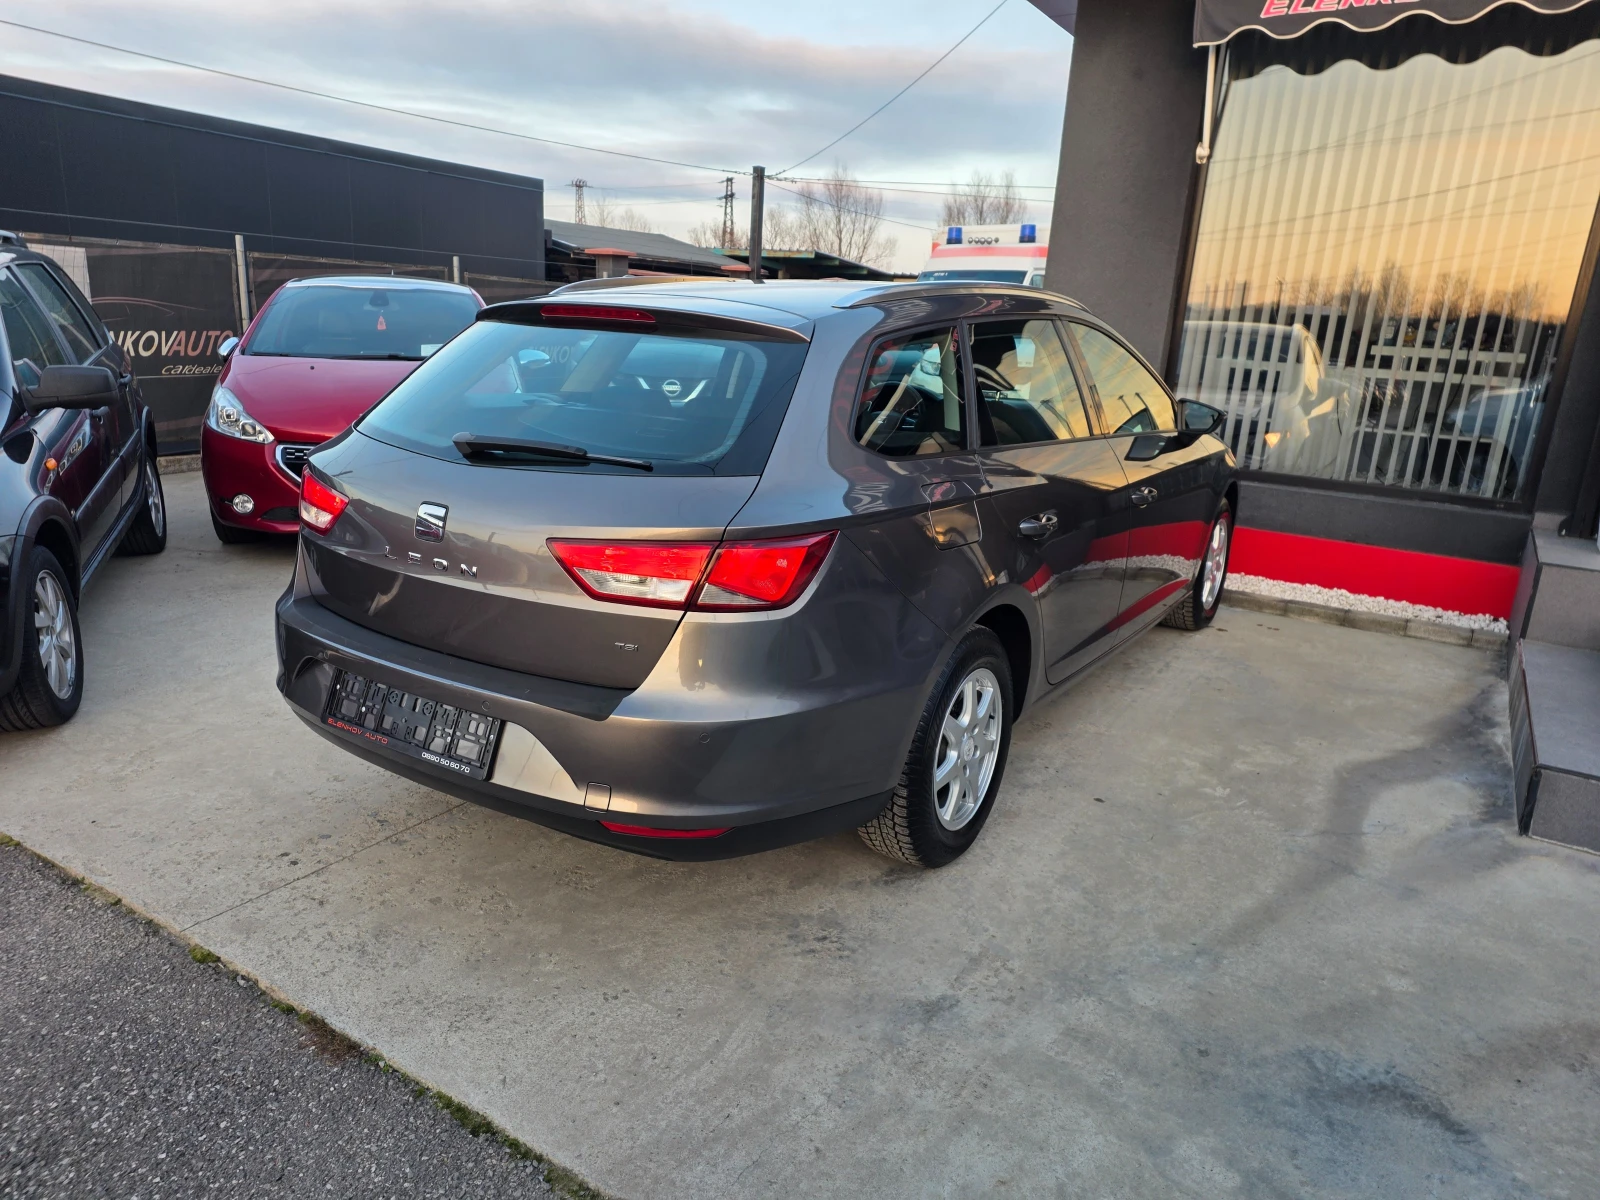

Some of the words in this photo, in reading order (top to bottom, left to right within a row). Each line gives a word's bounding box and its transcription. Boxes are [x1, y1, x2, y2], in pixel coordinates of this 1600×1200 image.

[384, 545, 478, 579] LEON
[364, 732, 389, 745] AUTO
[439, 757, 450, 766] 50
[460, 764, 471, 773] 70
